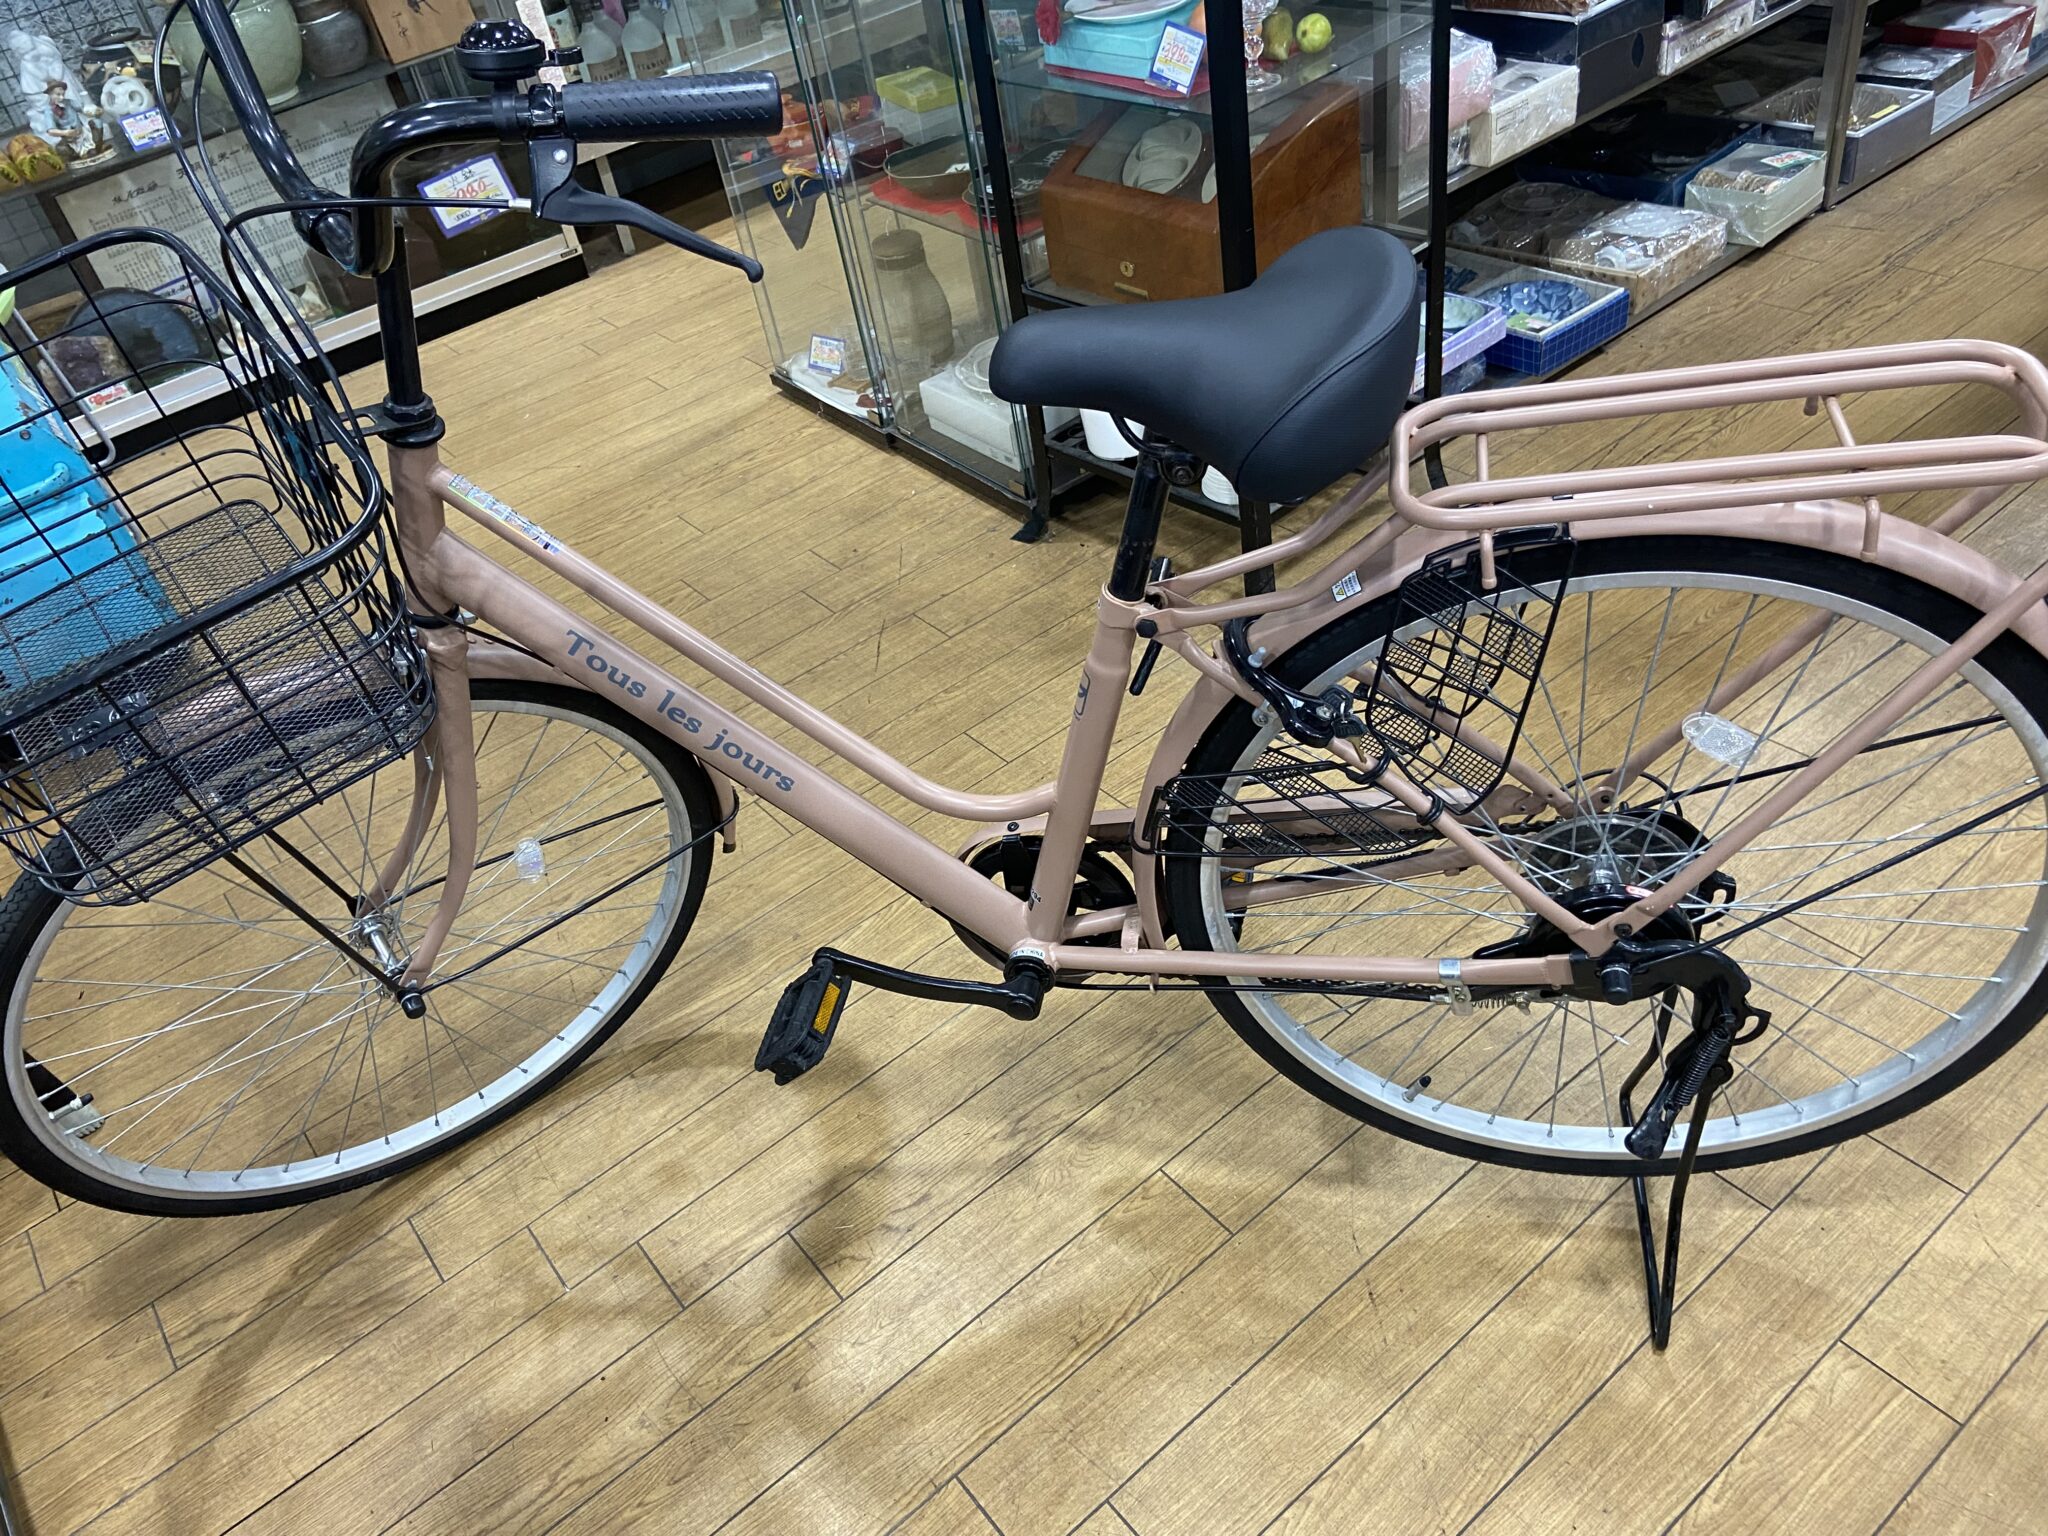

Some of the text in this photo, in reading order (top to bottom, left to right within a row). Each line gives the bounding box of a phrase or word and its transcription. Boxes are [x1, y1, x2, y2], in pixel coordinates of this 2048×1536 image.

[566, 629, 796, 792] Tous les jours
